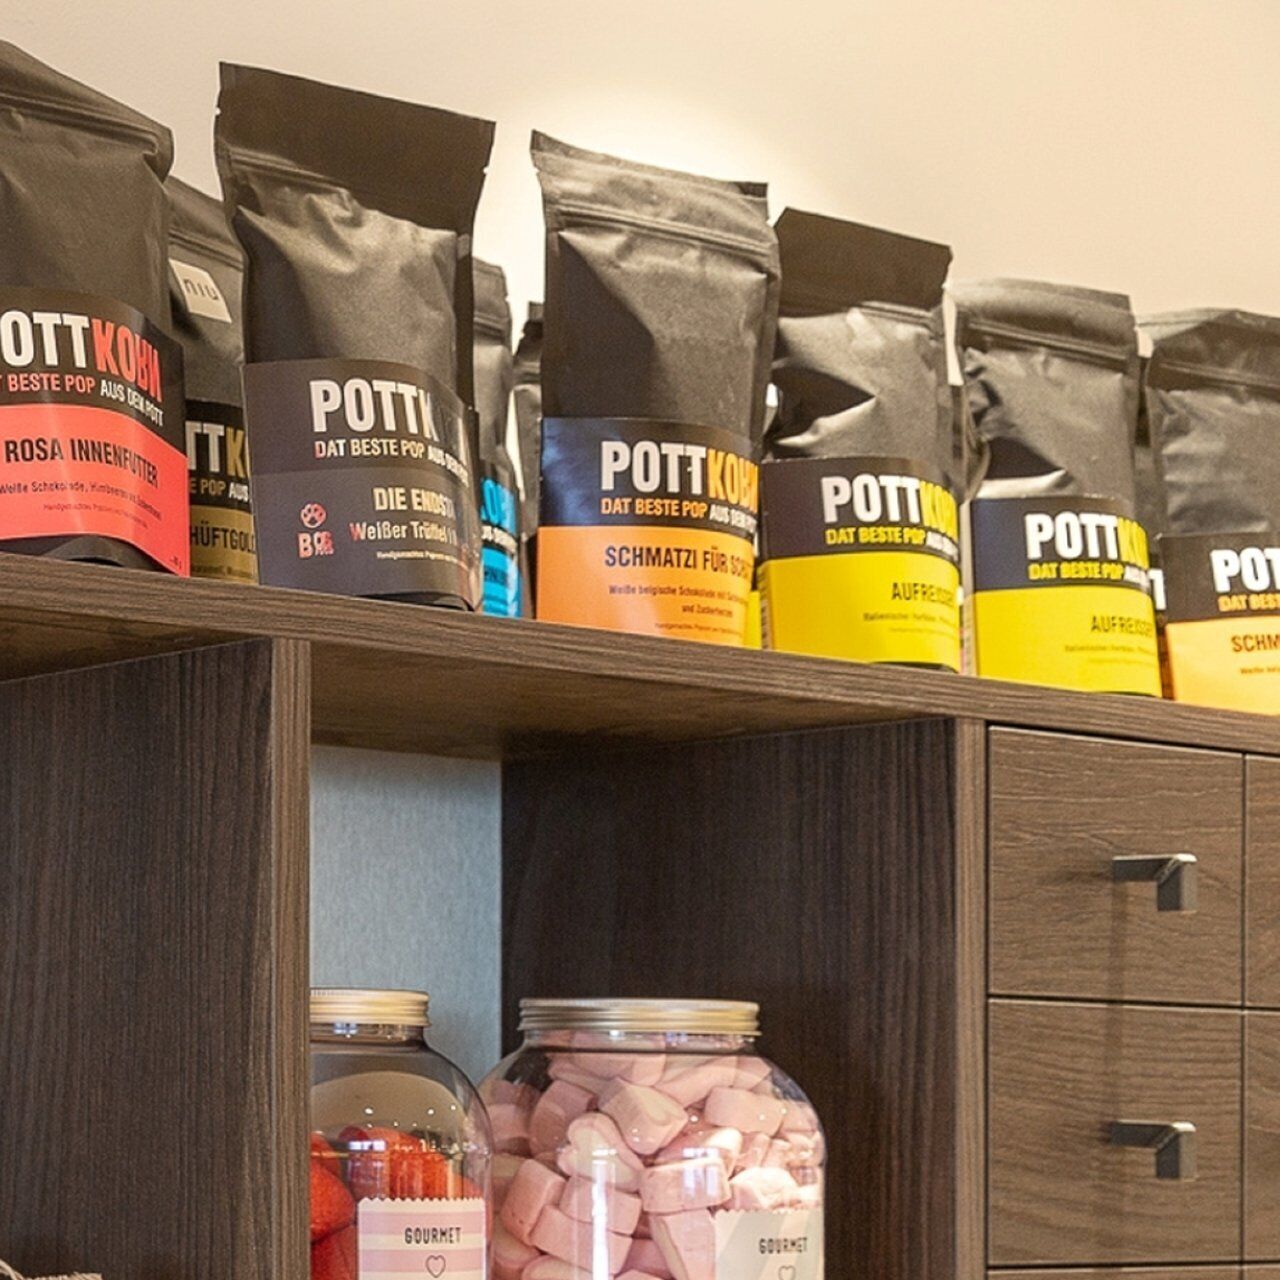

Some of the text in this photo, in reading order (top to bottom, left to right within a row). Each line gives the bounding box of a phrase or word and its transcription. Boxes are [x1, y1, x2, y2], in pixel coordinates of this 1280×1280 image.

[8, 373, 60, 391] BESTE
[65, 375, 95, 394] POP
[100, 380, 125, 402] AUS
[315, 439, 424, 459] DAT BESTE POP
[5, 438, 63, 463] ROSA
[70, 439, 159, 489] INNENFUTTER
[200, 479, 226, 495] POP
[373, 487, 408, 511] DIE
[601, 498, 708, 518] DAT BESTE POP
[350, 522, 407, 541] Weißer
[826, 528, 856, 545] DAT
[858, 527, 901, 545] BESTE
[605, 545, 728, 573] SCHMATZI FÜR
[1028, 563, 1057, 580] DAT
[404, 1227, 461, 1244] GOURMET
[759, 1237, 808, 1255] GOURMET
